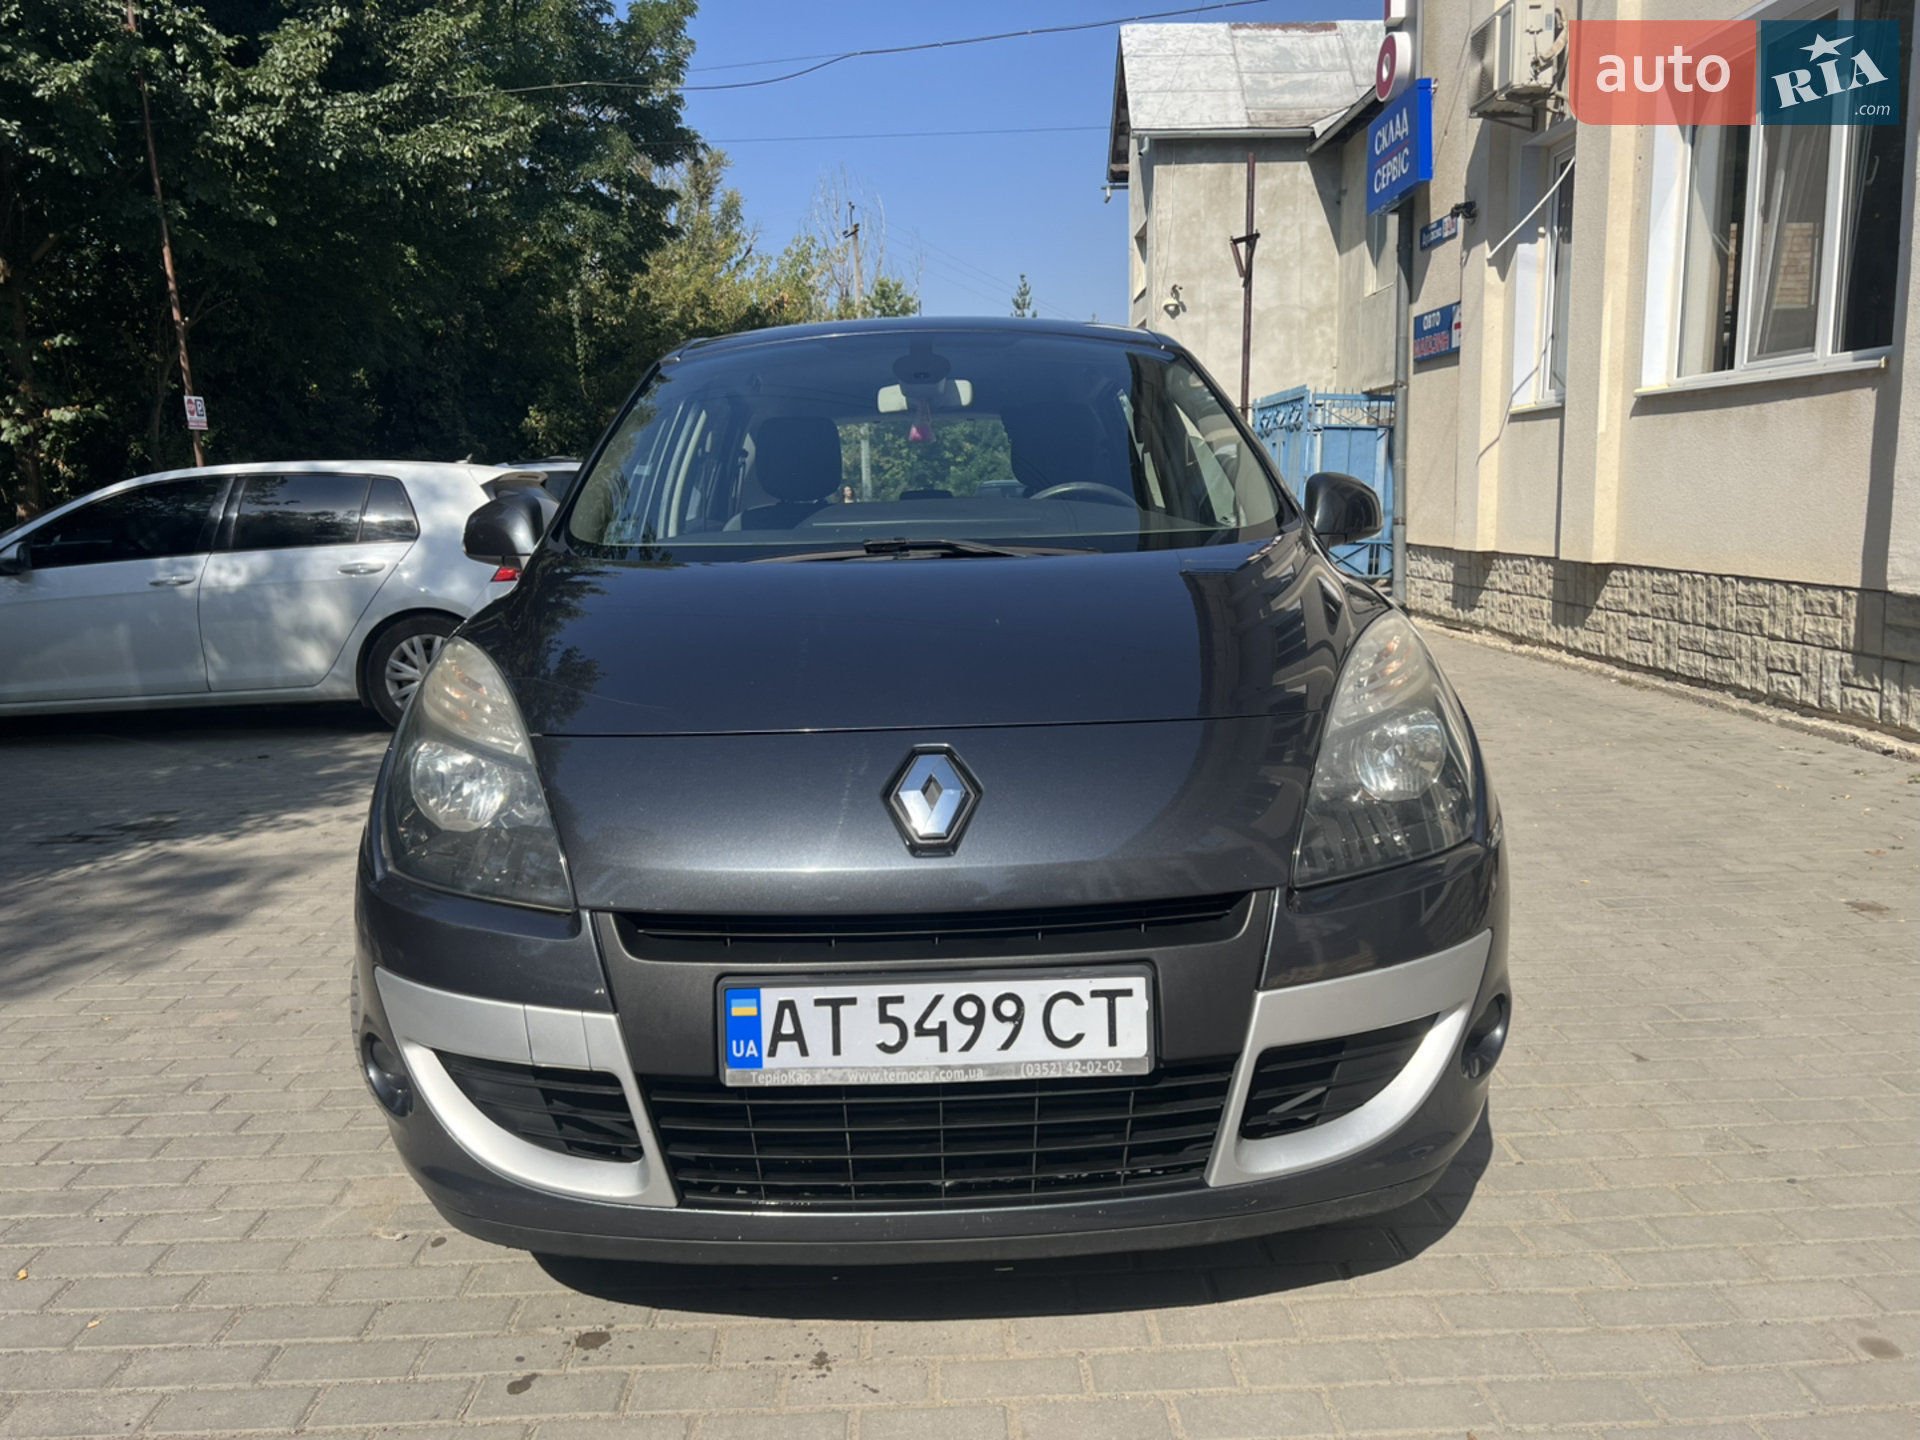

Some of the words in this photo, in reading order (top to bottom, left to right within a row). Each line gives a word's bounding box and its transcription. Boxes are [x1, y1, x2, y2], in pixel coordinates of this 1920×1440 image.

[1374, 107, 1409, 156] СКЛАД
[1373, 147, 1410, 194] СЕРВІС
[767, 996, 858, 1058] AT
[875, 991, 1026, 1055] 5499
[1042, 988, 1134, 1049] CT
[731, 1039, 759, 1058] UA
[847, 1066, 984, 1083] www.ternocar.com.ua
[1020, 1061, 1062, 1078] (0352)
[1066, 1059, 1123, 1076] 42-02-02
